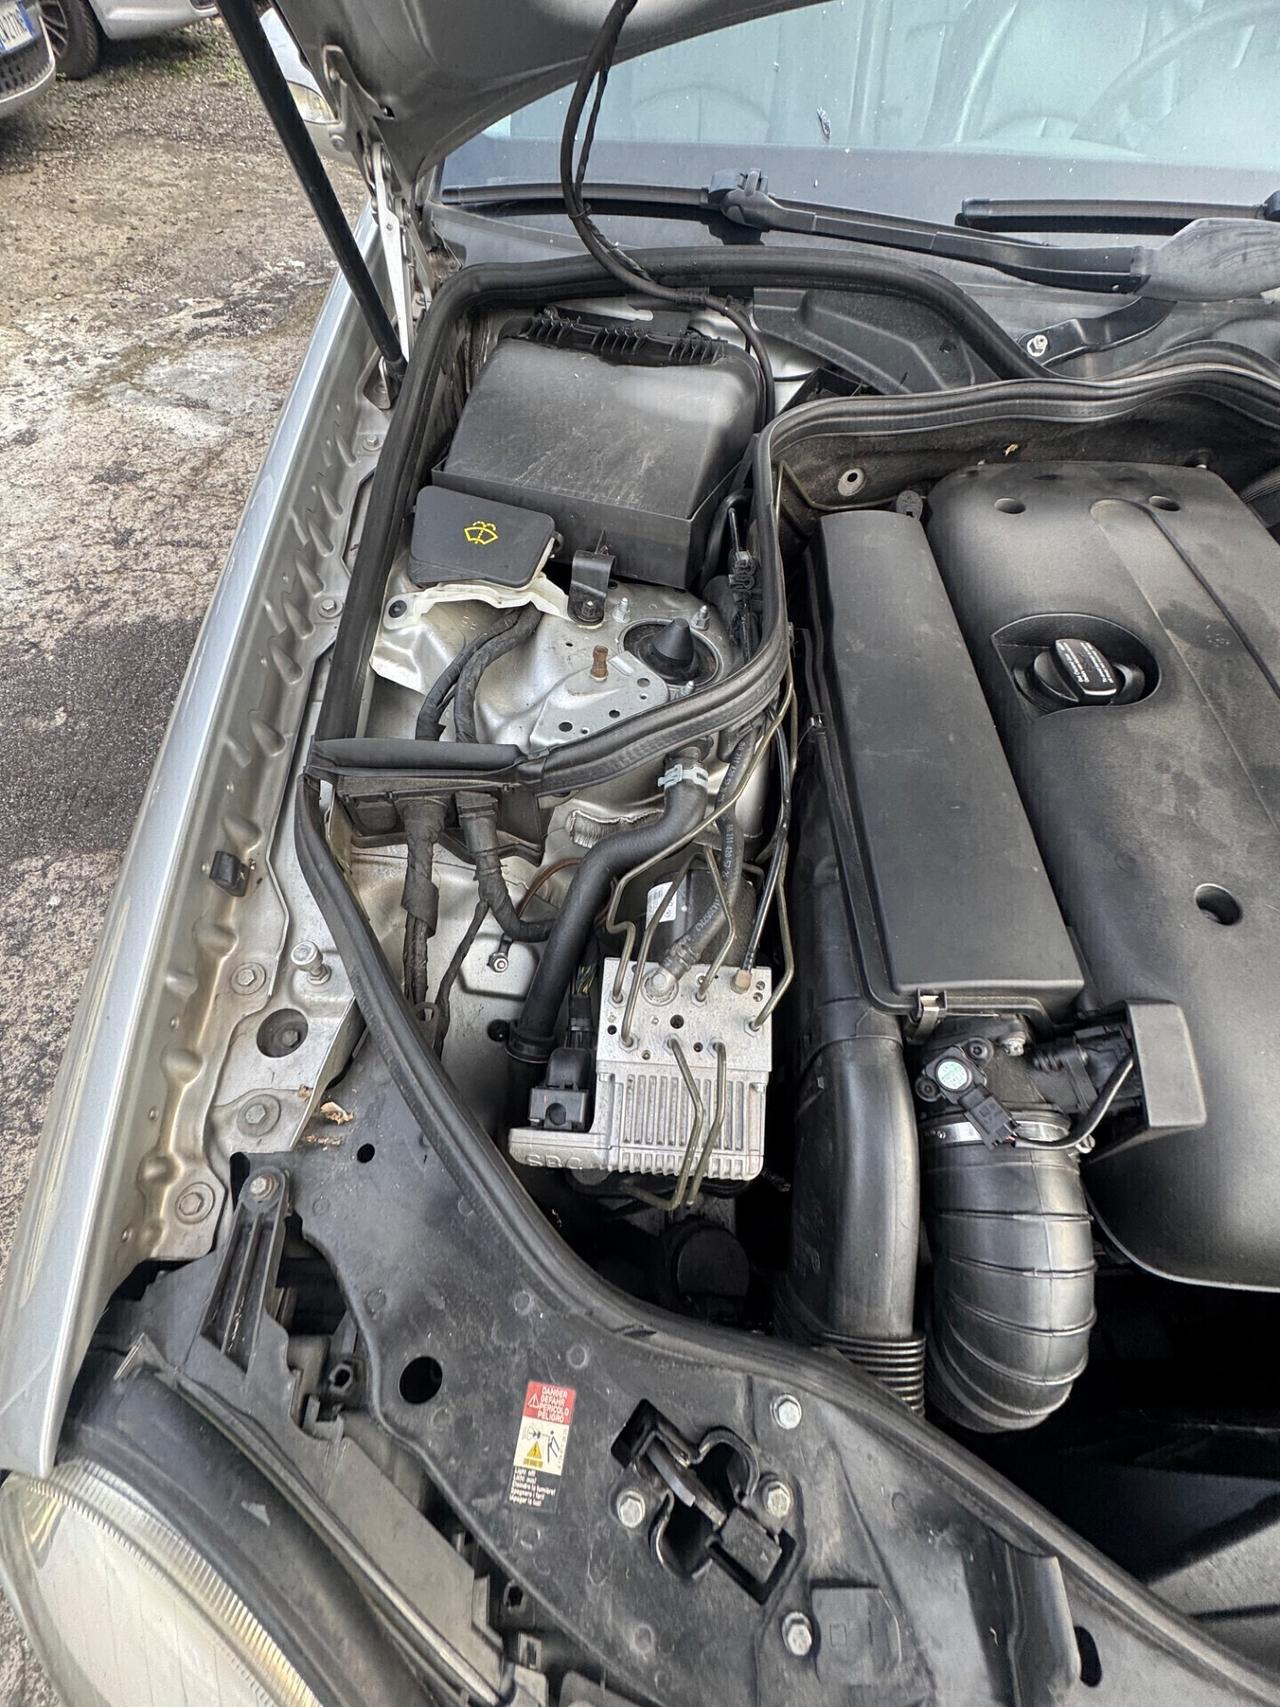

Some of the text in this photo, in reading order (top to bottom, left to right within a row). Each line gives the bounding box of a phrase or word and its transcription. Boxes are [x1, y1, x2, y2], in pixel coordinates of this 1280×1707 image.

[541, 1386, 568, 1398] DANGER
[540, 1394, 566, 1407] GEFAHR
[539, 1402, 570, 1416] PERICOLO
[537, 1410, 564, 1423] PELIGRO
